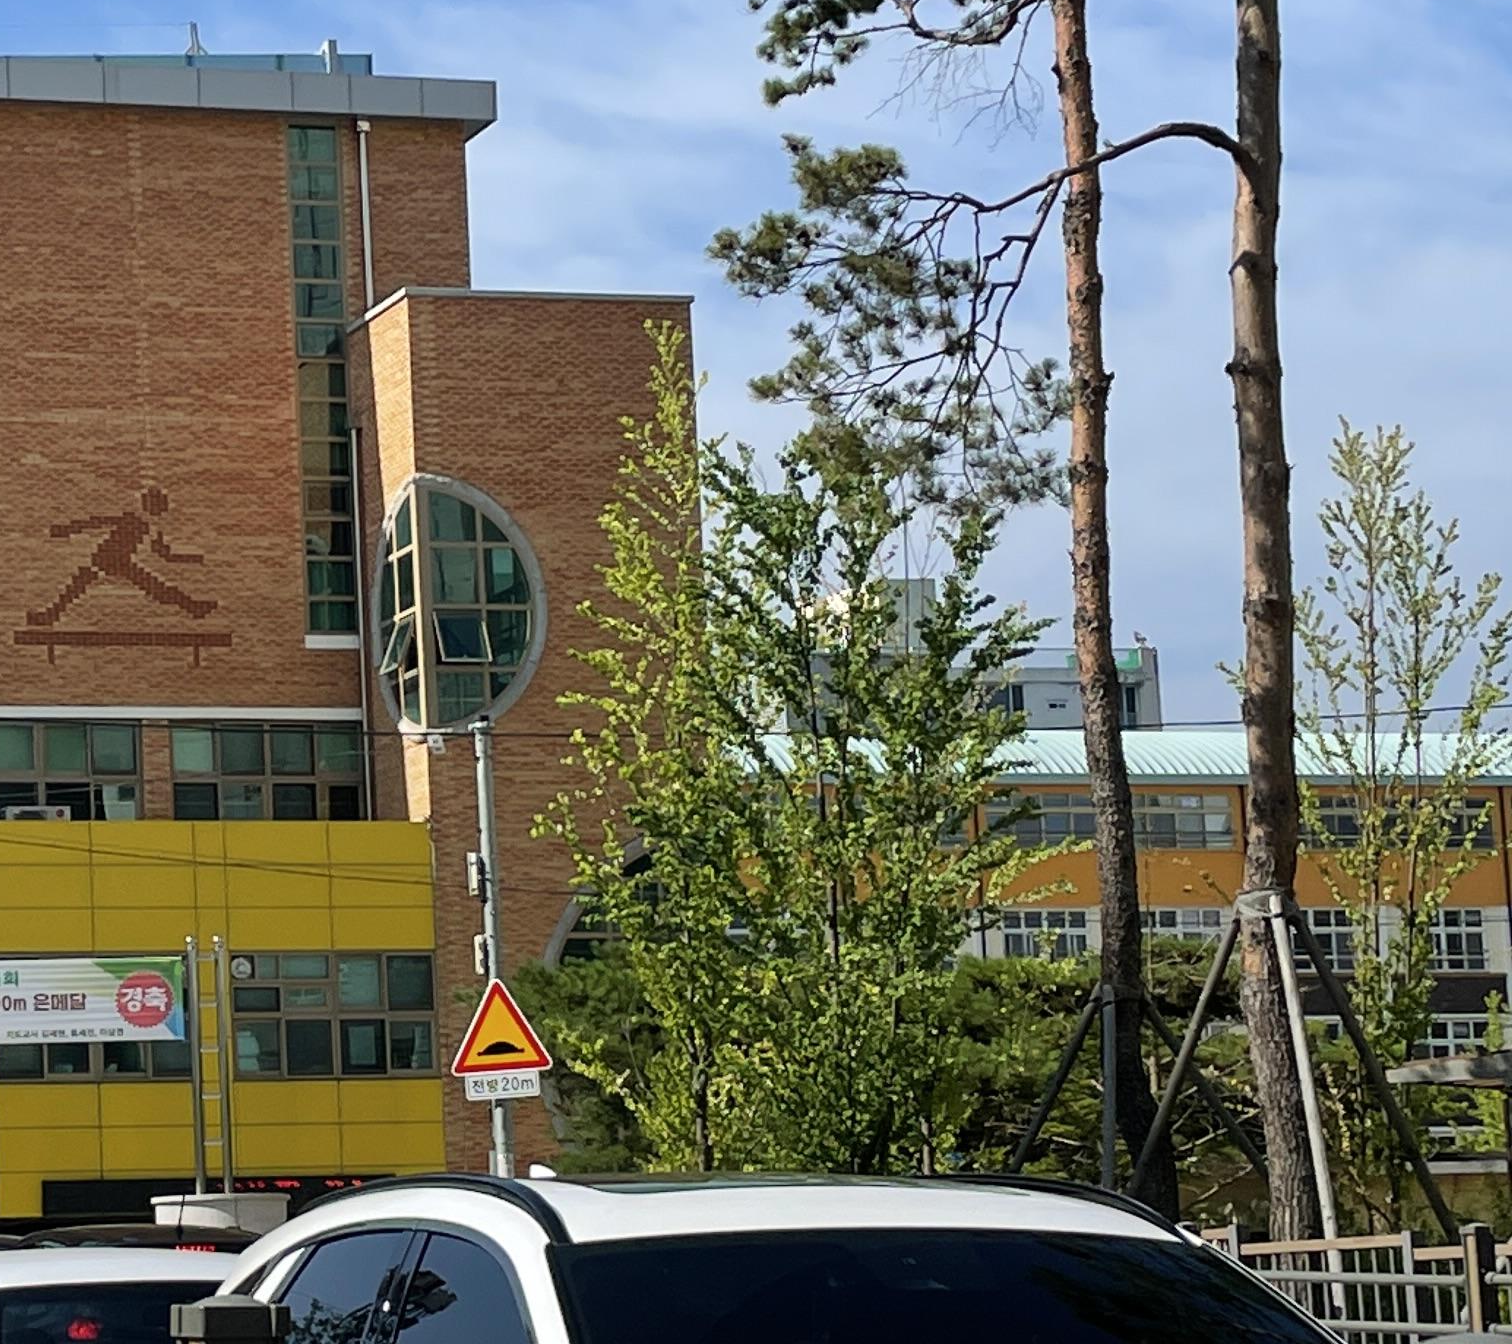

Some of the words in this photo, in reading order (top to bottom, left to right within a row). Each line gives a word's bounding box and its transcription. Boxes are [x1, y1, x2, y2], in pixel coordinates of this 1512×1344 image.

[33, 993, 87, 1011] 은메달
[120, 987, 169, 1012] 경축
[472, 1078, 498, 1094] 전방
[502, 1076, 535, 1091] 20m
